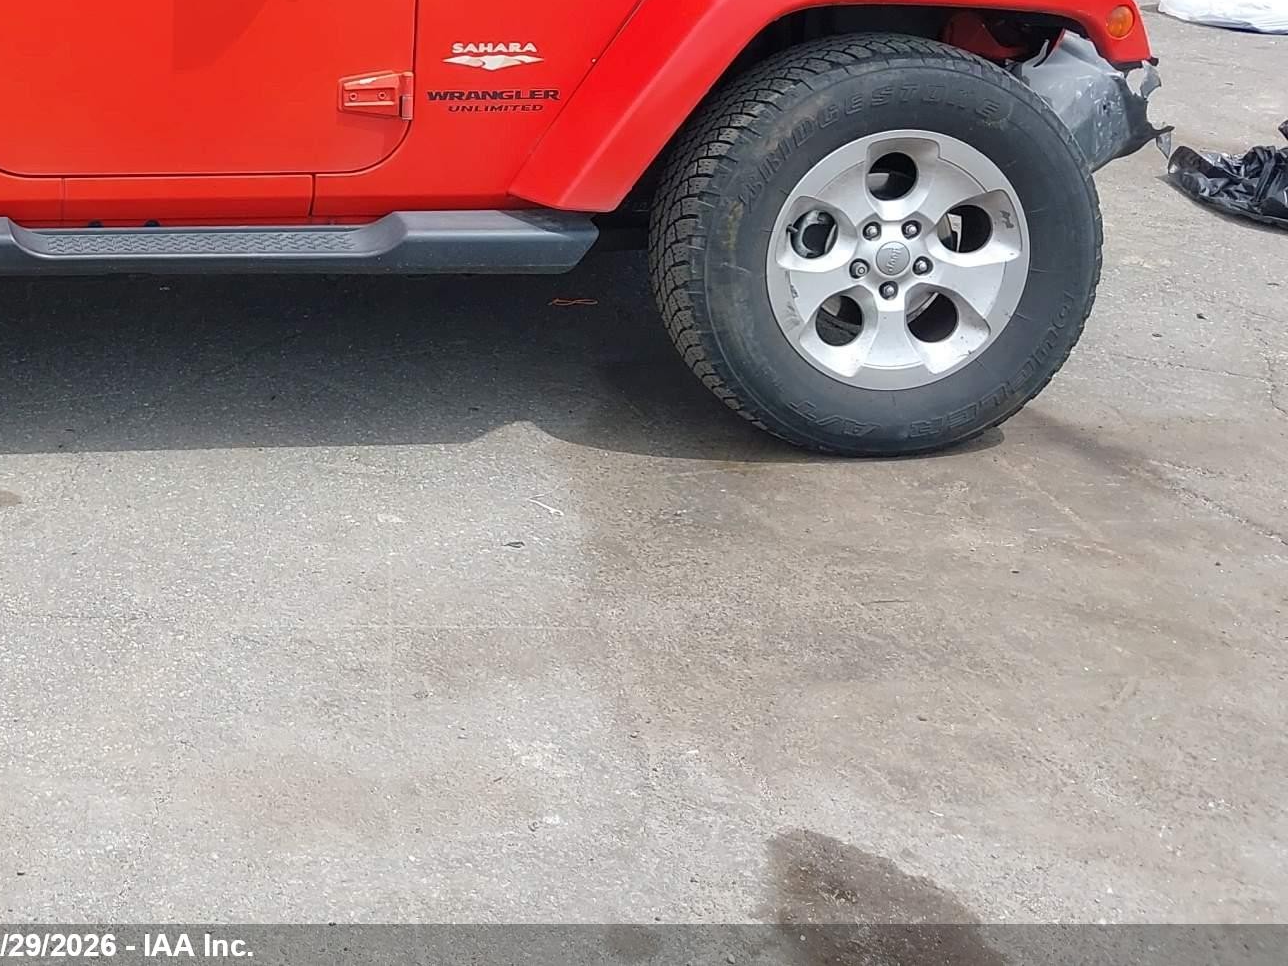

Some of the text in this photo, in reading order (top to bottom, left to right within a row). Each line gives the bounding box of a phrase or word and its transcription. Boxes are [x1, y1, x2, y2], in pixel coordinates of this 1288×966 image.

[452, 42, 537, 53] SAHARA
[427, 90, 560, 101] WRANGLER
[448, 104, 544, 112] UNLIMITED
